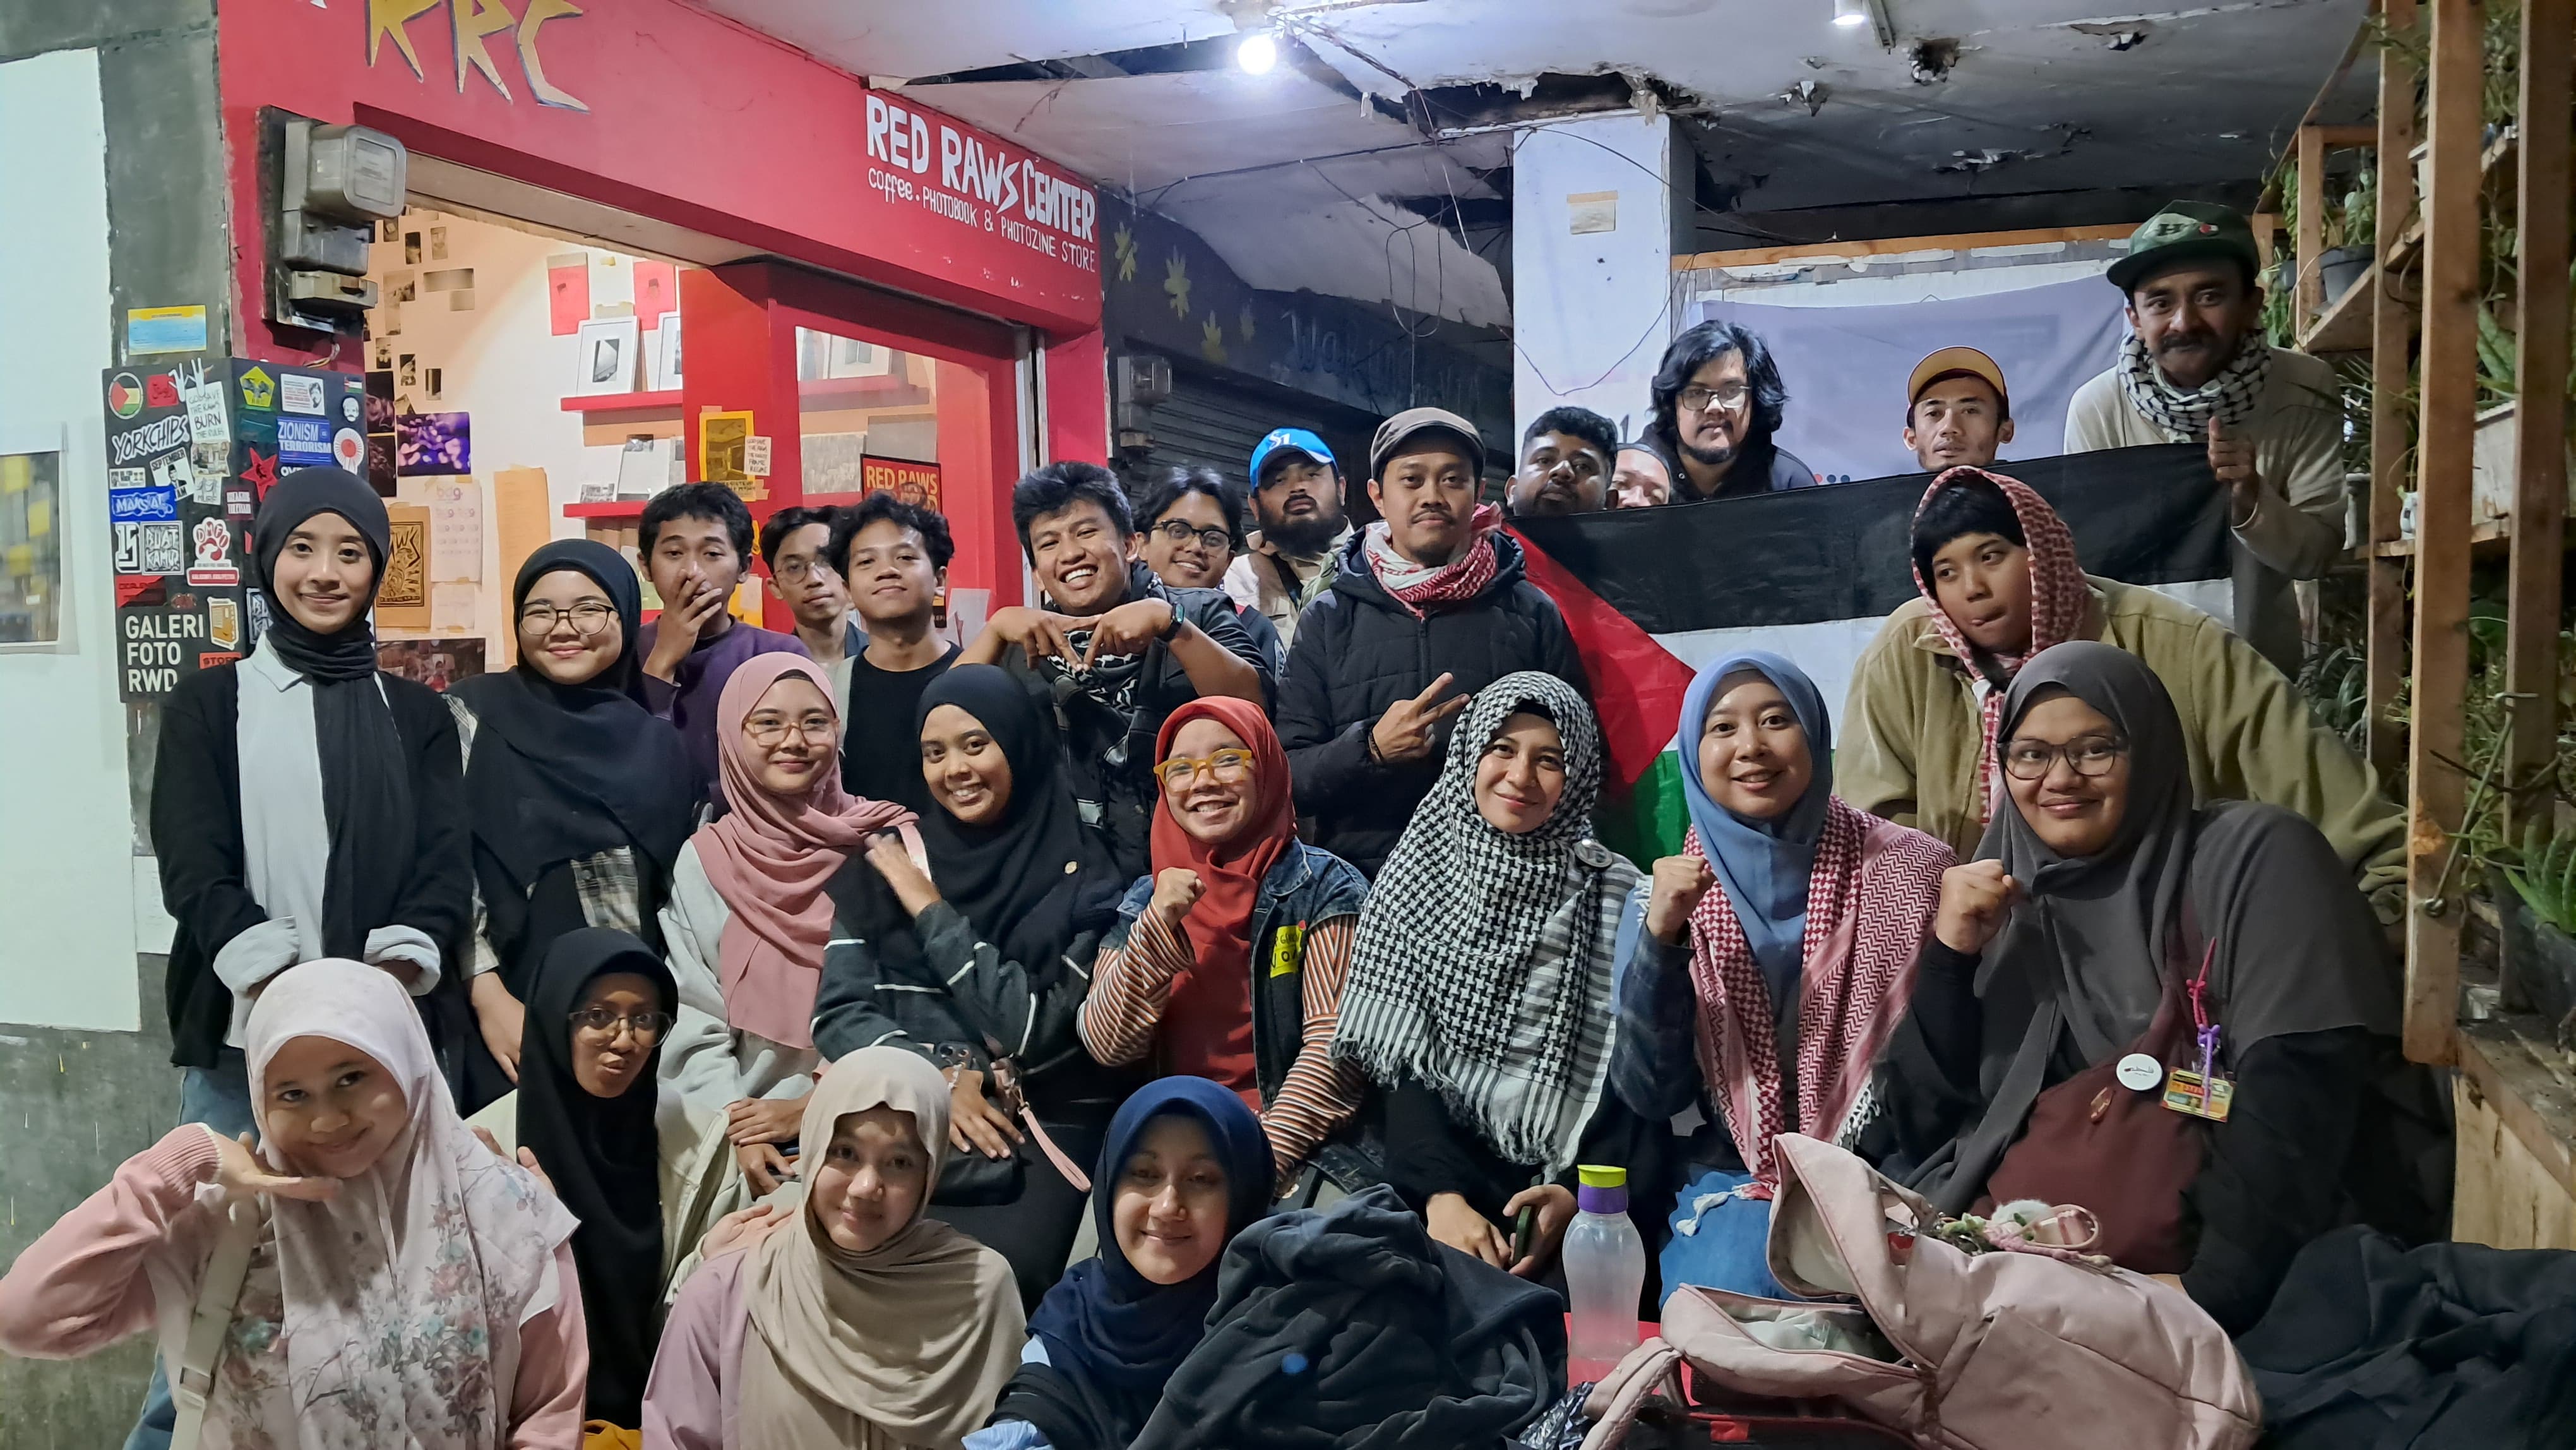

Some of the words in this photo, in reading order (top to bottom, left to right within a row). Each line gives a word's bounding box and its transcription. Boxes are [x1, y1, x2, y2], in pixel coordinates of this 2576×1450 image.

[866, 94, 929, 174] RED
[940, 124, 1020, 215] RAWS
[923, 185, 978, 228] PHOTOBOOK
[984, 209, 994, 232] &
[1001, 215, 1056, 258] PHOTOZINE
[1061, 241, 1095, 273] STORE
[194, 412, 222, 430] BURN
[277, 421, 319, 441] ZIONISM
[278, 440, 332, 454] TERRORISM
[152, 449, 186, 471] SEPTEMBER
[866, 465, 895, 490] RED
[146, 527, 179, 549] BUAT
[125, 614, 204, 639] GALERI
[127, 642, 181, 666] FOTO
[128, 668, 178, 692] RWD
